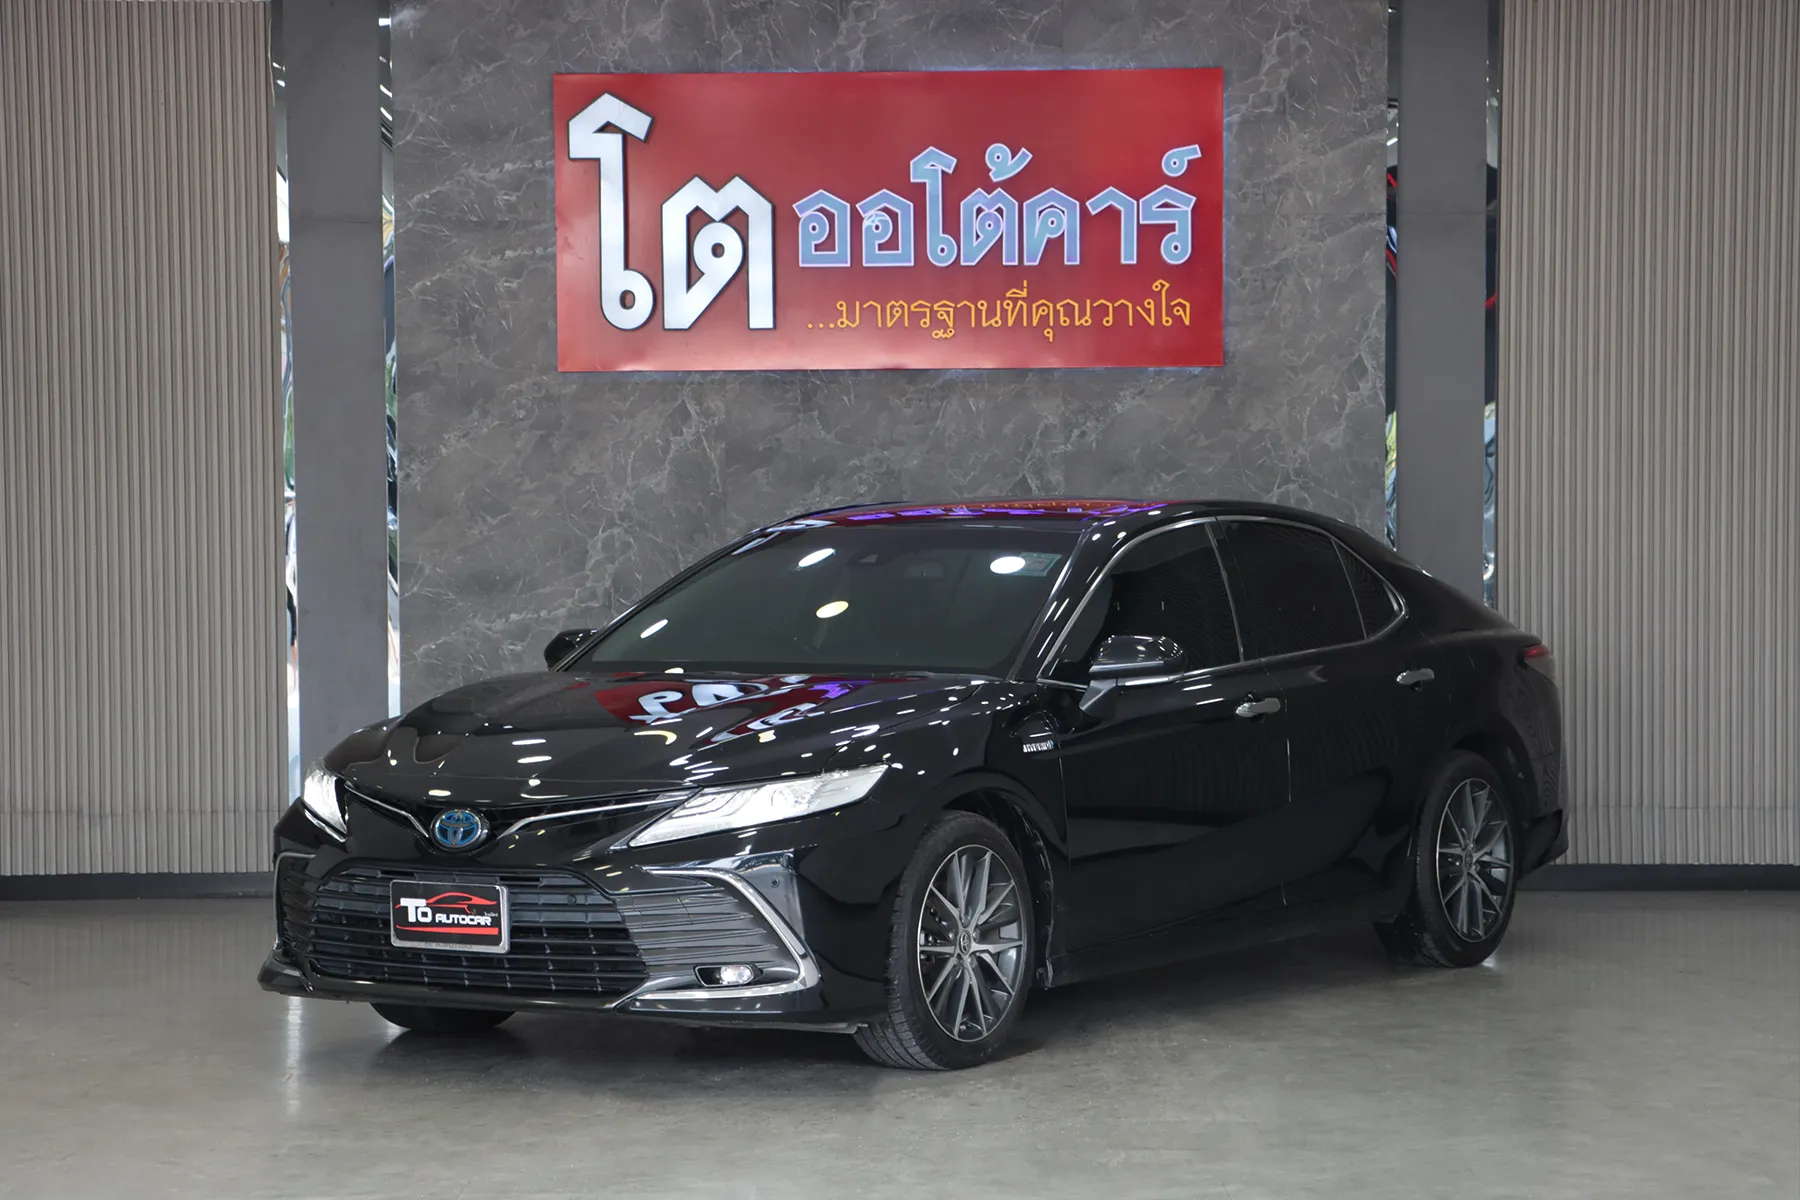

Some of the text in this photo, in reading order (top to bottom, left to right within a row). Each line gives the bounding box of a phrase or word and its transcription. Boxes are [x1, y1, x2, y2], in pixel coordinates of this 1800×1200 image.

[568, 92, 1201, 331] โต ออโต้คาร์
[435, 913, 492, 926] AUTOCAR
